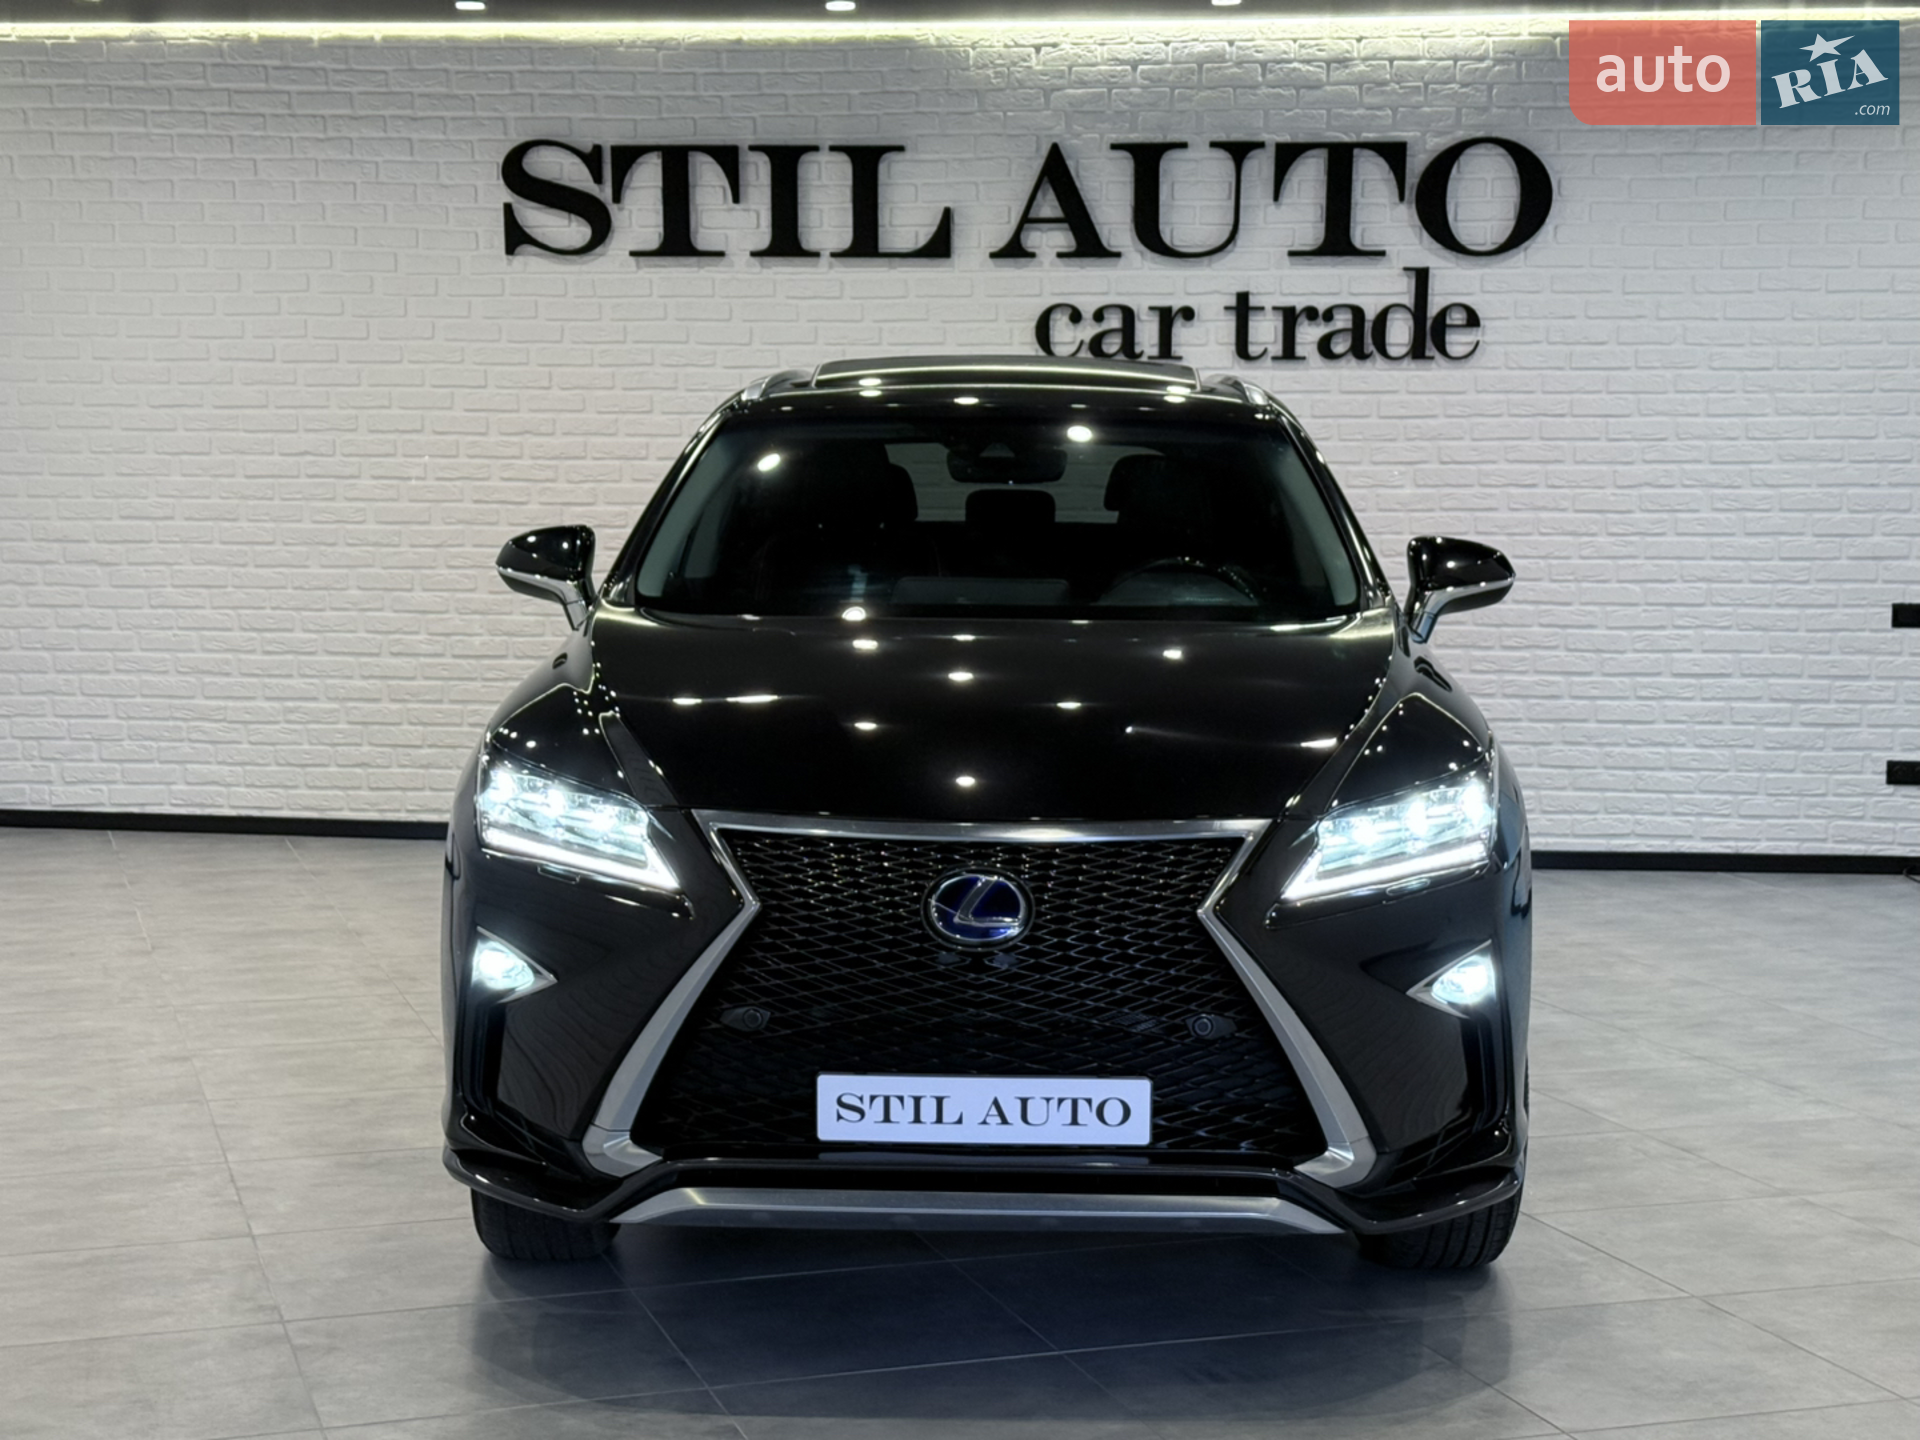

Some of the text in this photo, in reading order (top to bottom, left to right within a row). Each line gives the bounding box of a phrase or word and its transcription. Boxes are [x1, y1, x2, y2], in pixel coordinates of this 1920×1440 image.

[502, 136, 1553, 259] STIL AUTO
[1035, 266, 1481, 361] car trade
[835, 1092, 1131, 1126] STIL AUTO
